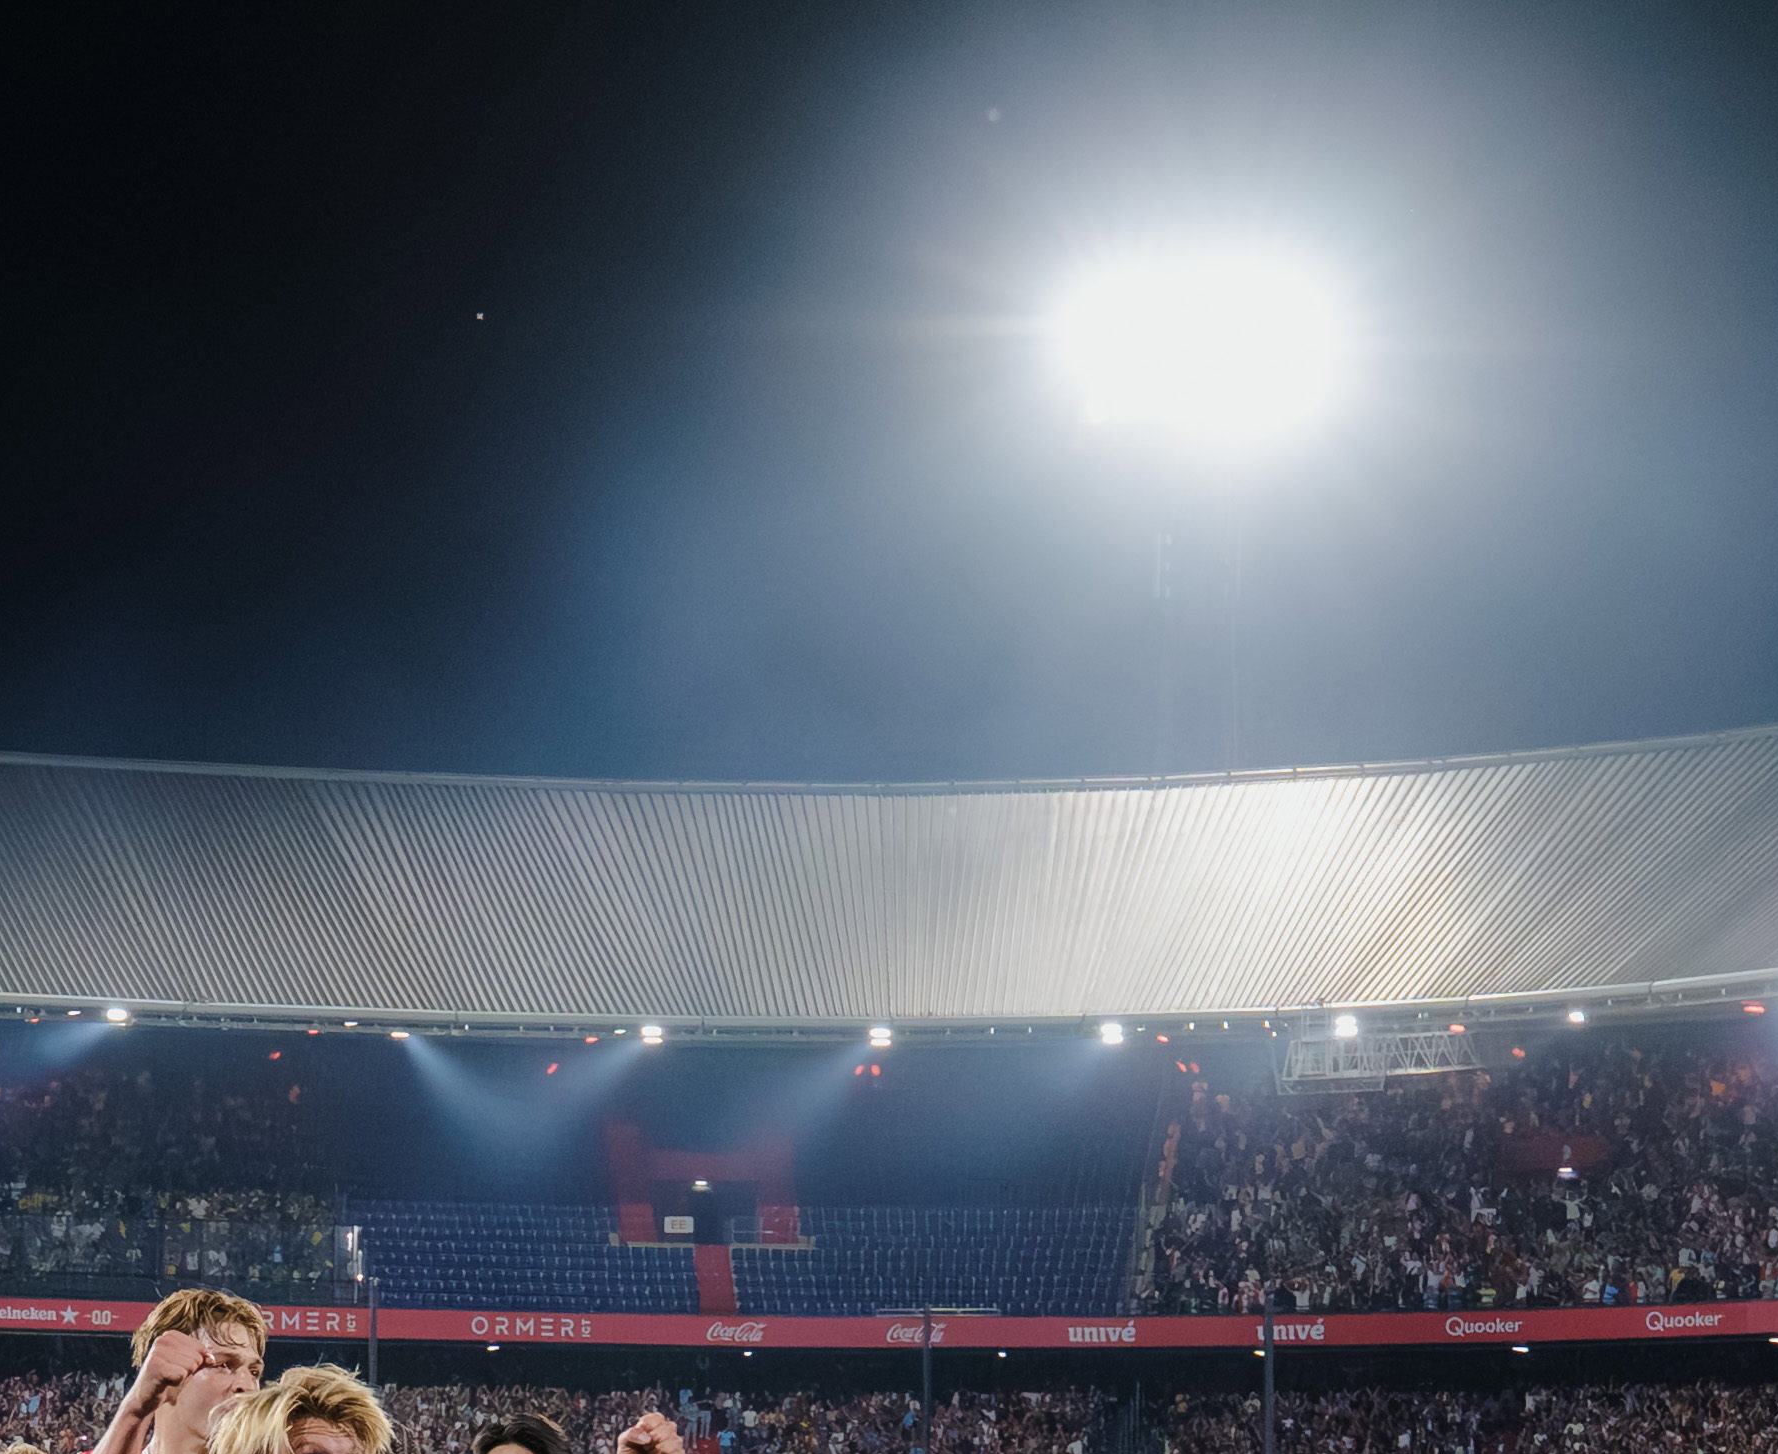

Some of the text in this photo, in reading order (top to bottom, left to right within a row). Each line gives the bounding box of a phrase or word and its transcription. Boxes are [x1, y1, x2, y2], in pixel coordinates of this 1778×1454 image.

[268, 1310, 340, 1332] RMER
[471, 1316, 575, 1337] ORMER
[1068, 1320, 1136, 1343] univé
[1446, 1316, 1522, 1337] Quooker
[1646, 1310, 1721, 1332] Quooker
